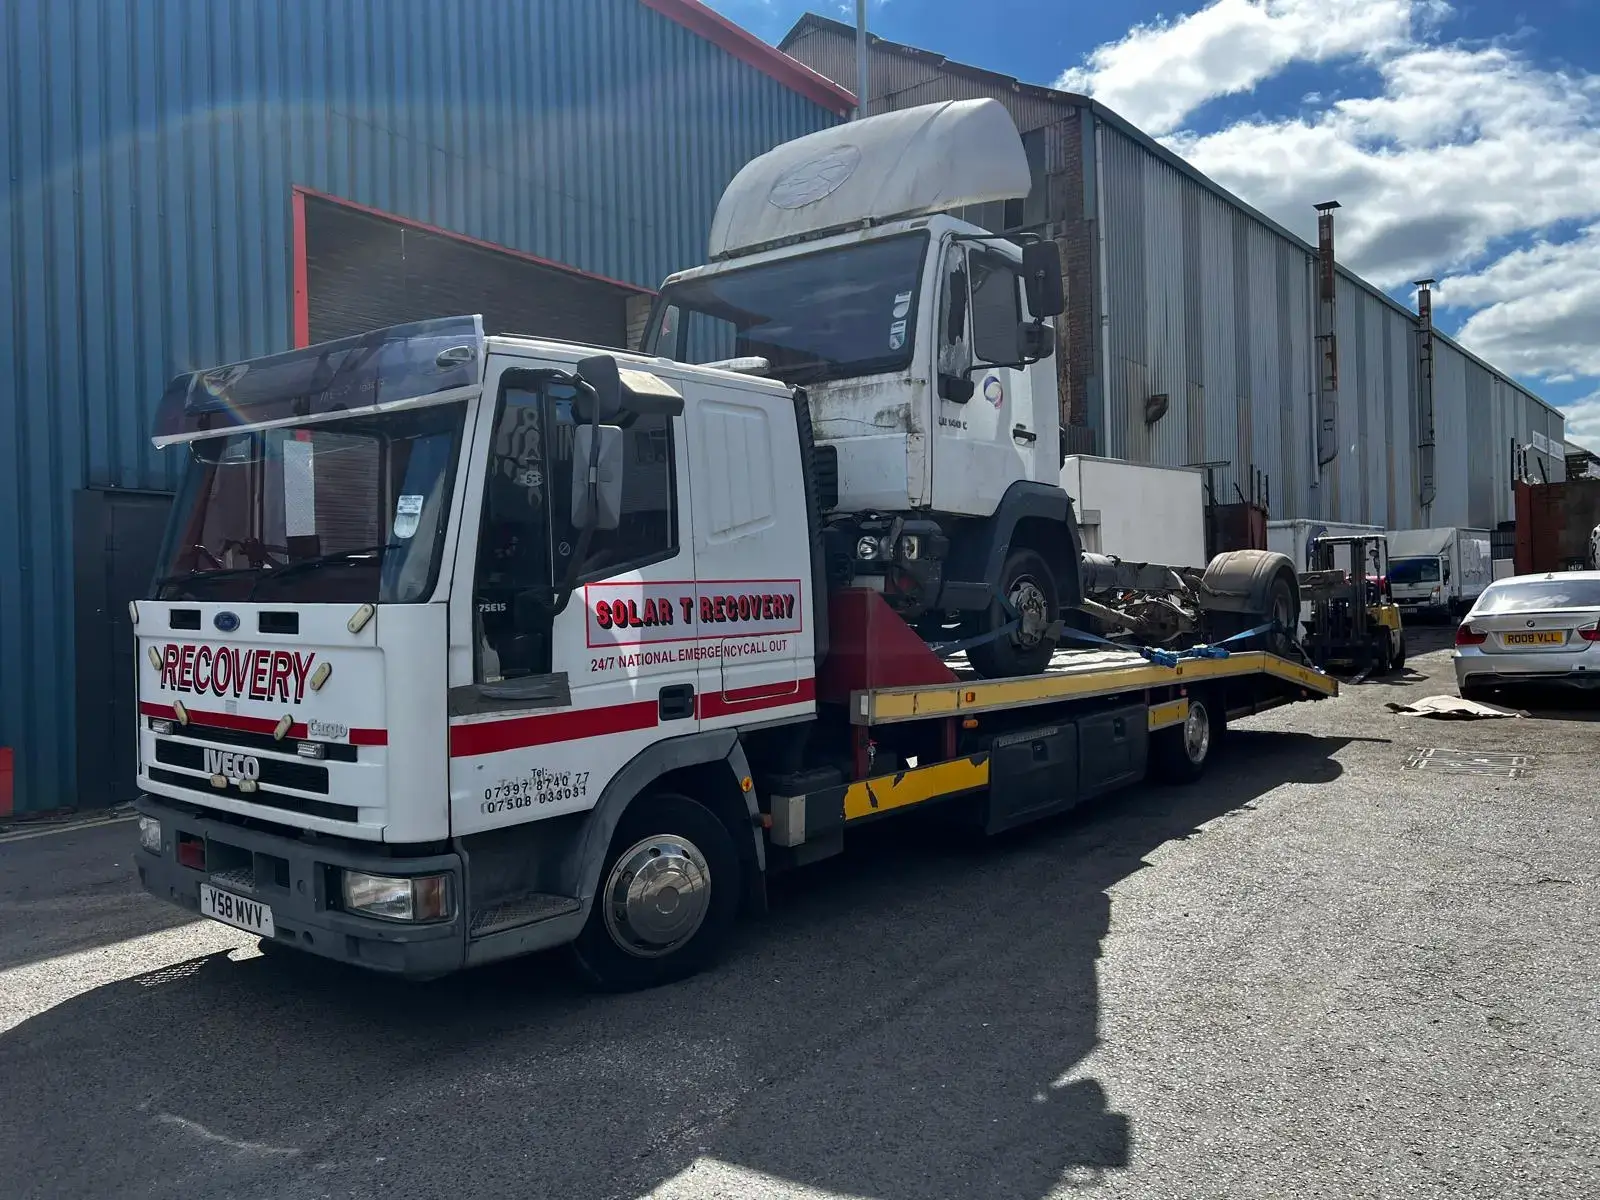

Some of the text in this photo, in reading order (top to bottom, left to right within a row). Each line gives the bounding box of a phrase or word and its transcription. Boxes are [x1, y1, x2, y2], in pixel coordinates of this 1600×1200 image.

[479, 603, 507, 612] 75E15
[596, 594, 796, 630] SOLAR T RECOVERY
[591, 657, 614, 672] 24/7
[618, 651, 675, 668] NATIONAL
[769, 639, 788, 652] OUT
[161, 644, 315, 704] RECOVERY
[308, 718, 348, 739] Cargo
[204, 748, 260, 780] IVECO
[531, 767, 548, 778] Tel:
[484, 782, 529, 800] 07397
[536, 775, 569, 791] 8740
[487, 795, 532, 813] 07508
[209, 889, 262, 929] Y58 MVV
